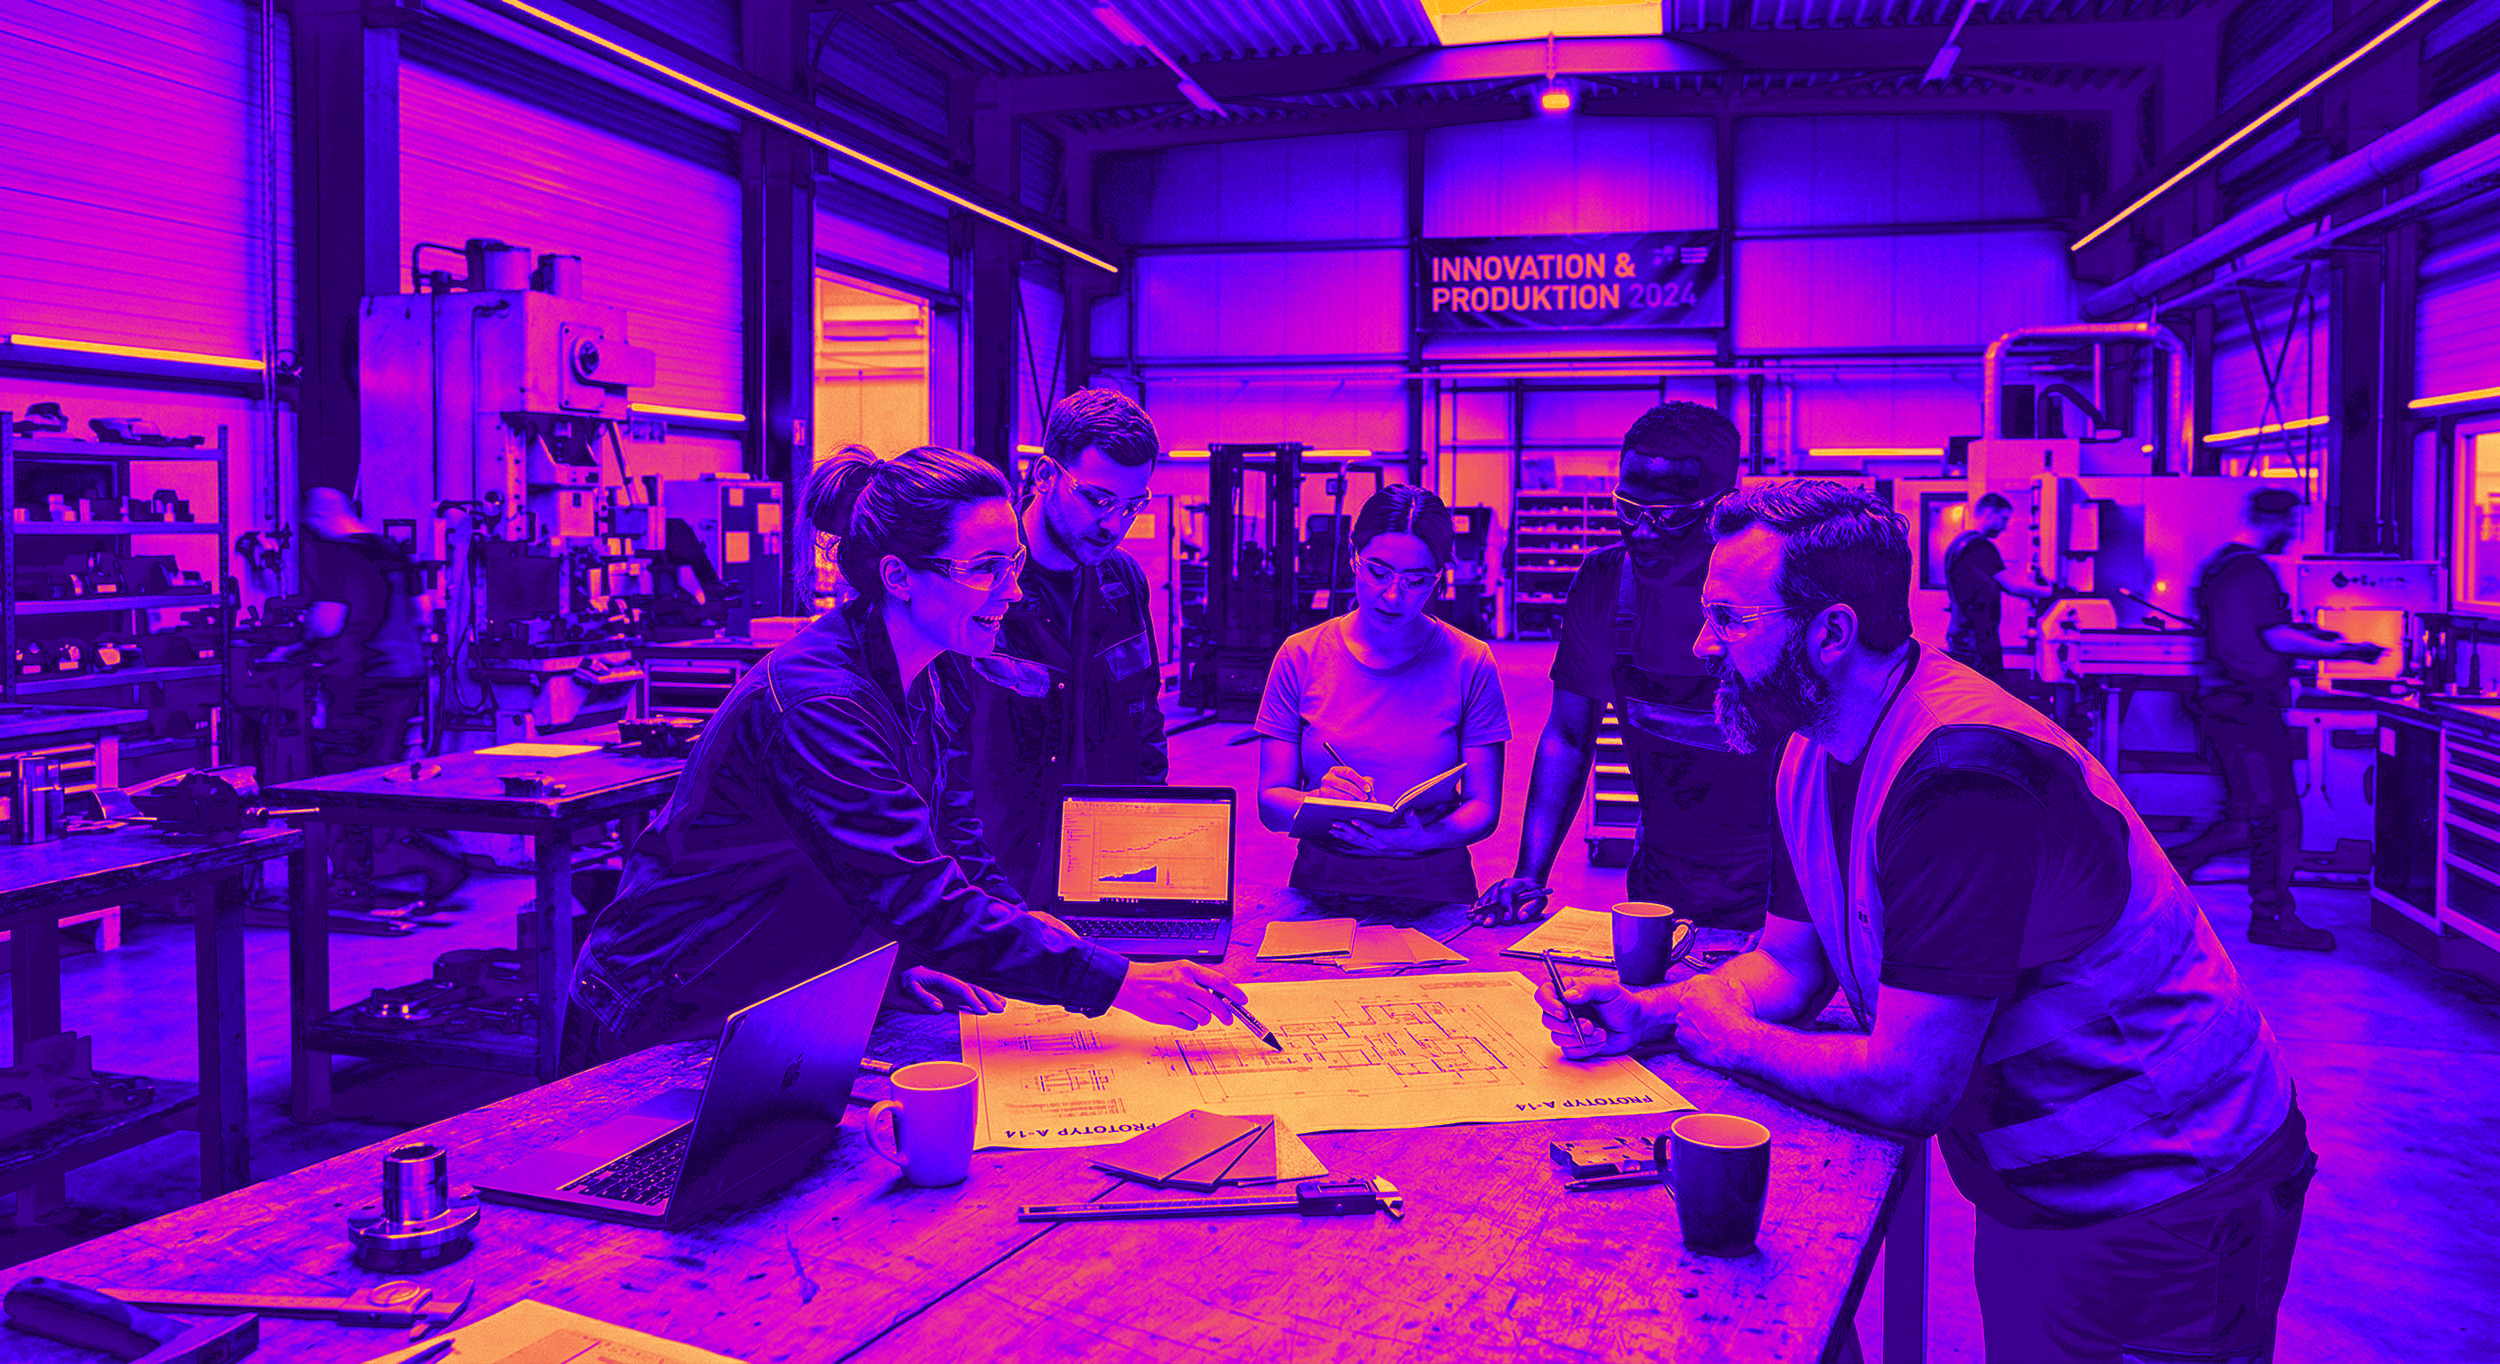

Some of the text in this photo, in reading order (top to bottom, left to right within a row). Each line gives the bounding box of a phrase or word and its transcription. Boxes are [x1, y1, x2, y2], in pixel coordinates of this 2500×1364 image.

[1432, 251, 1637, 282] INNOVATION &
[1432, 281, 1697, 313] PRODUKTION 2024
[1515, 1094, 1654, 1111] PROTOTYP A-14
[1005, 1128, 1050, 1139] A-14
